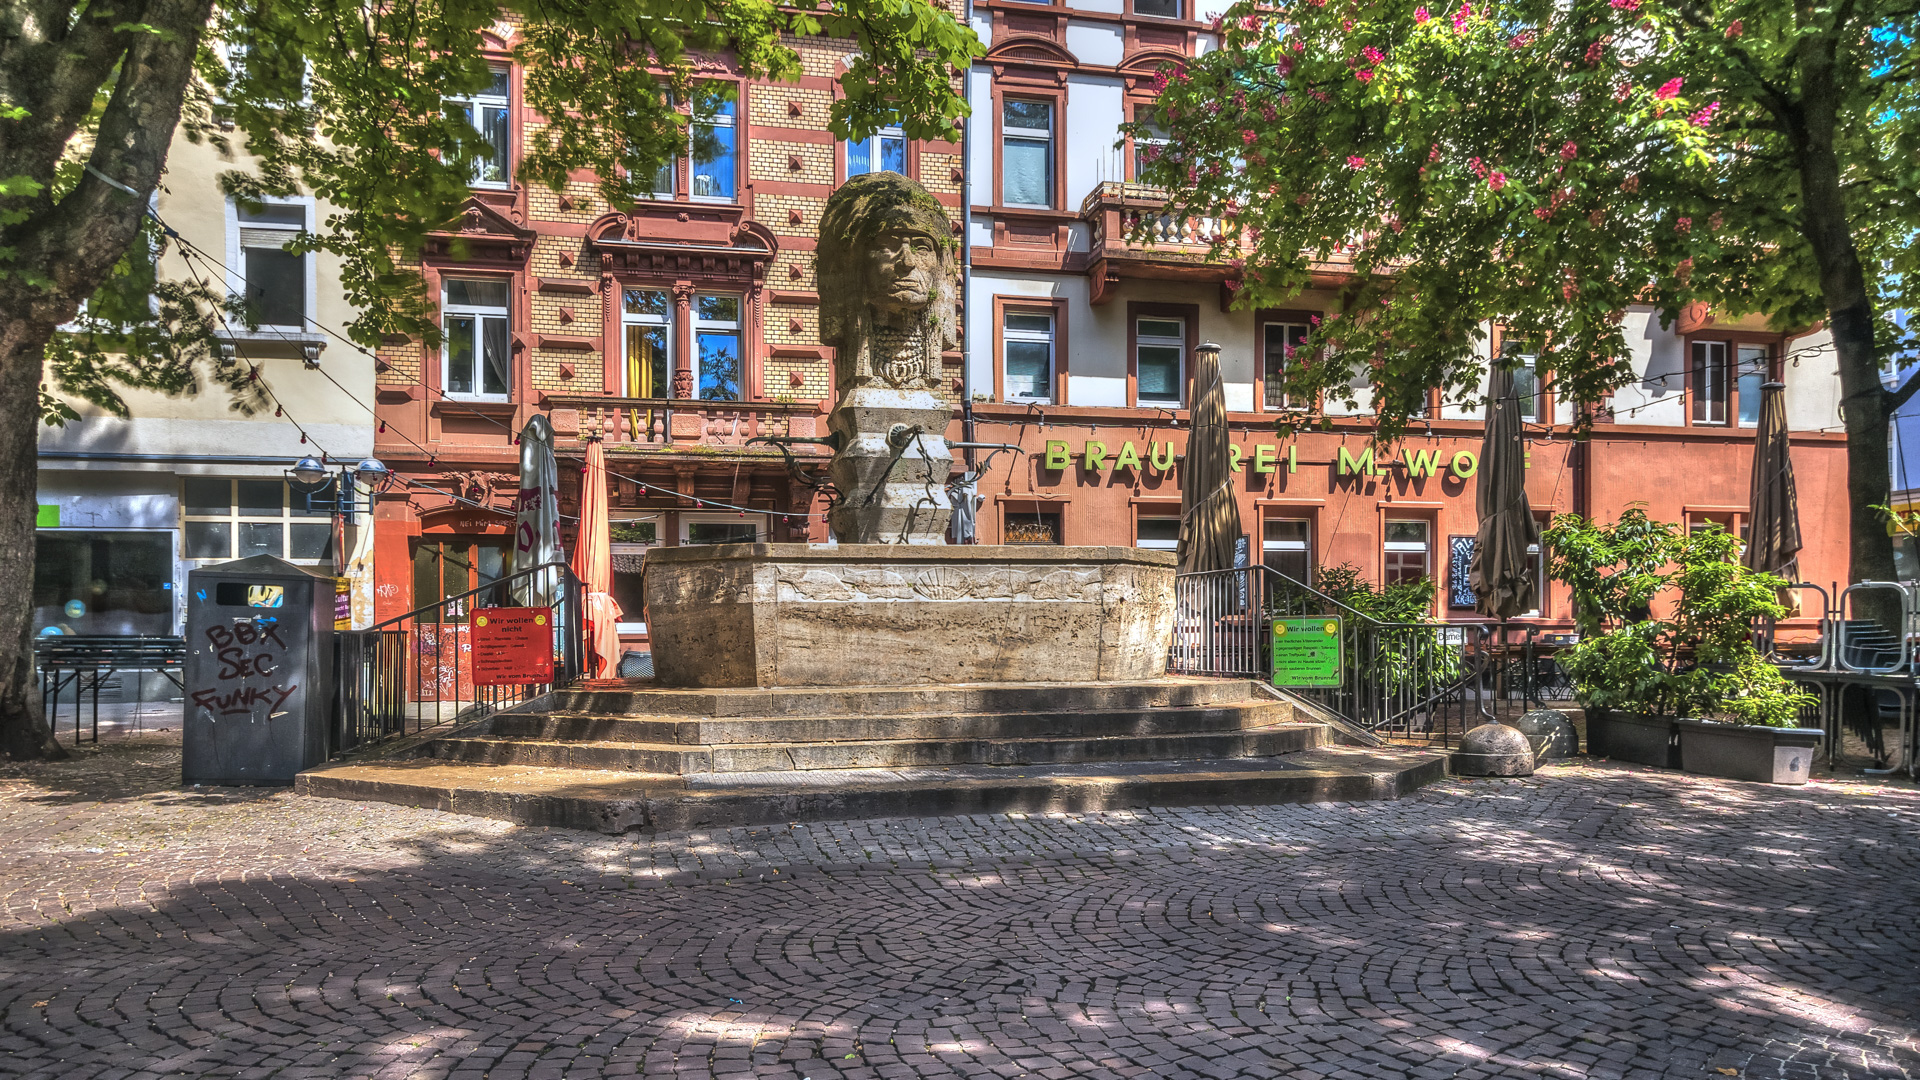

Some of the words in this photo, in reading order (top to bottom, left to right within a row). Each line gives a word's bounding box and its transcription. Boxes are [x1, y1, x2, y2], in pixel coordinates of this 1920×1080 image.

[1045, 440, 1296, 474] BRAUREI
[489, 617, 504, 625] Wir
[191, 685, 298, 721] FUNKY
